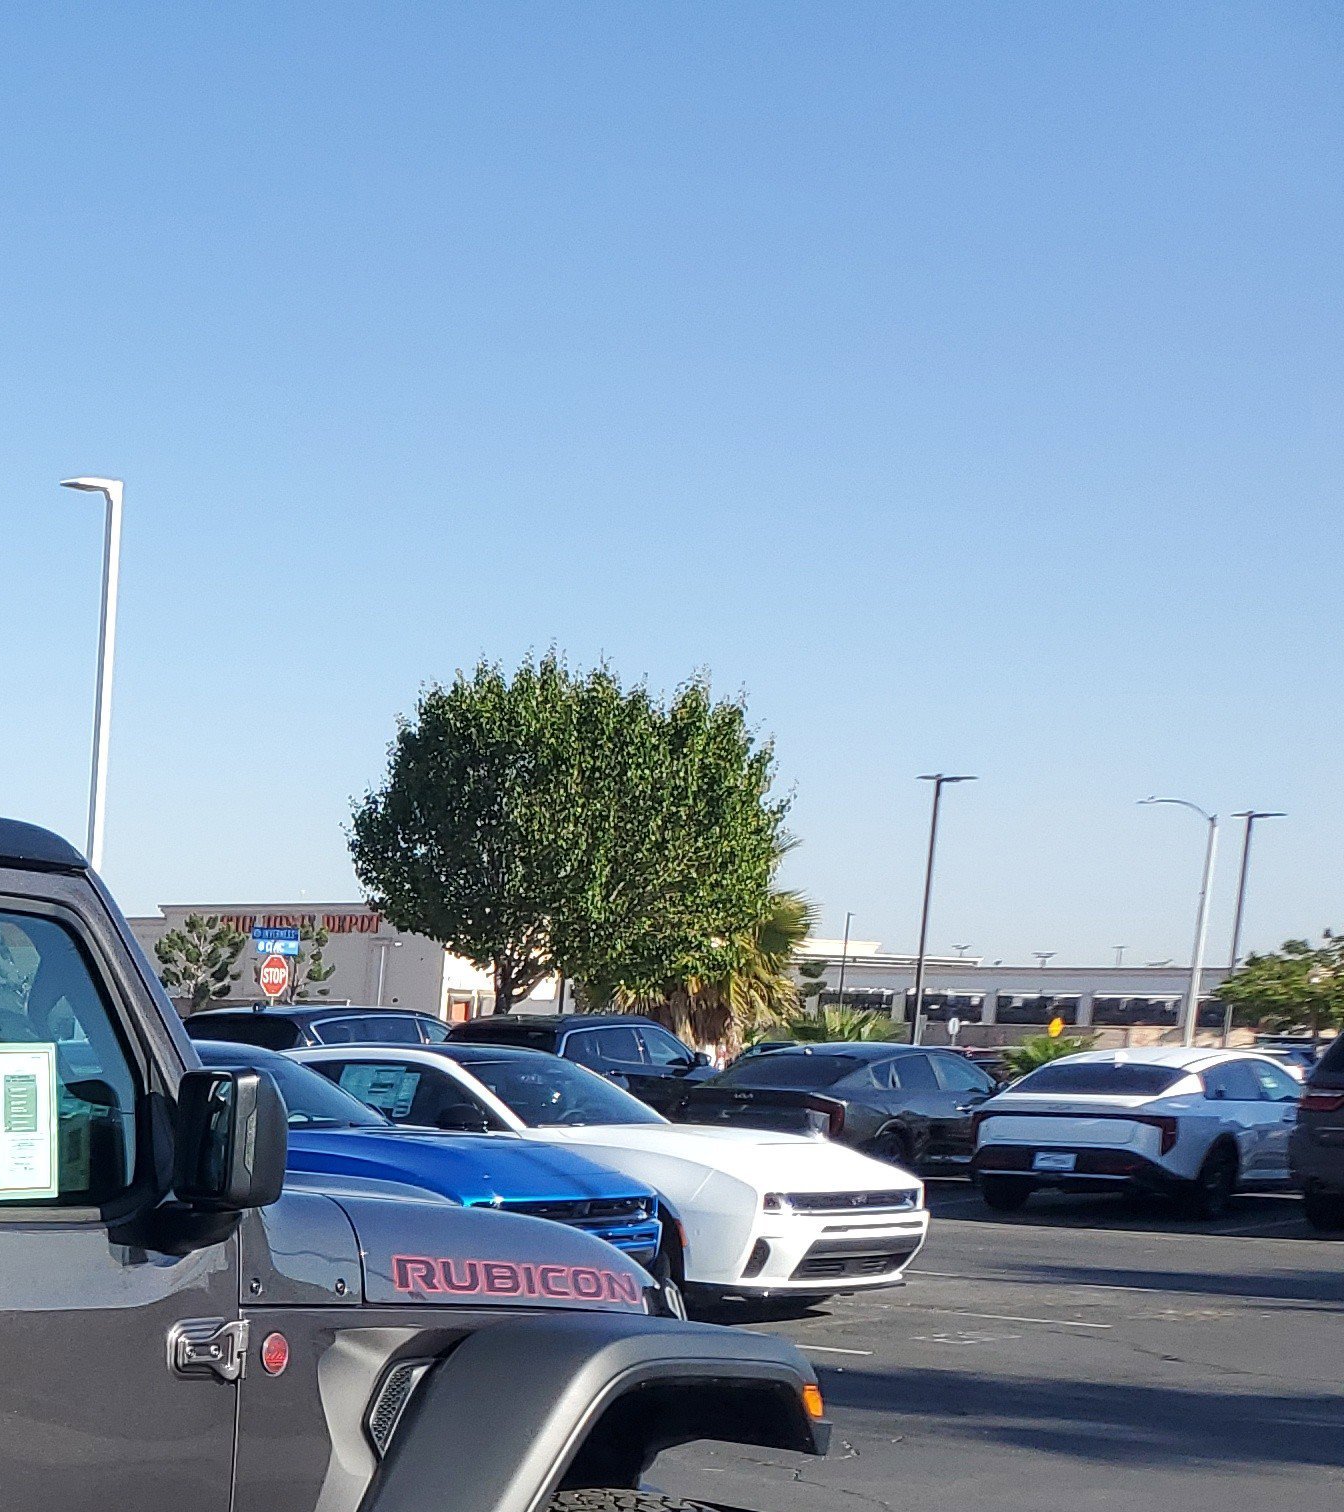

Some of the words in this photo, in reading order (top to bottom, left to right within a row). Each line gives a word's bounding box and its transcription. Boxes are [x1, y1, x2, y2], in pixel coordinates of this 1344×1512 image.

[322, 914, 381, 933] DEPOT
[263, 967, 287, 984] STOP
[392, 1254, 641, 1304] RUBICON
